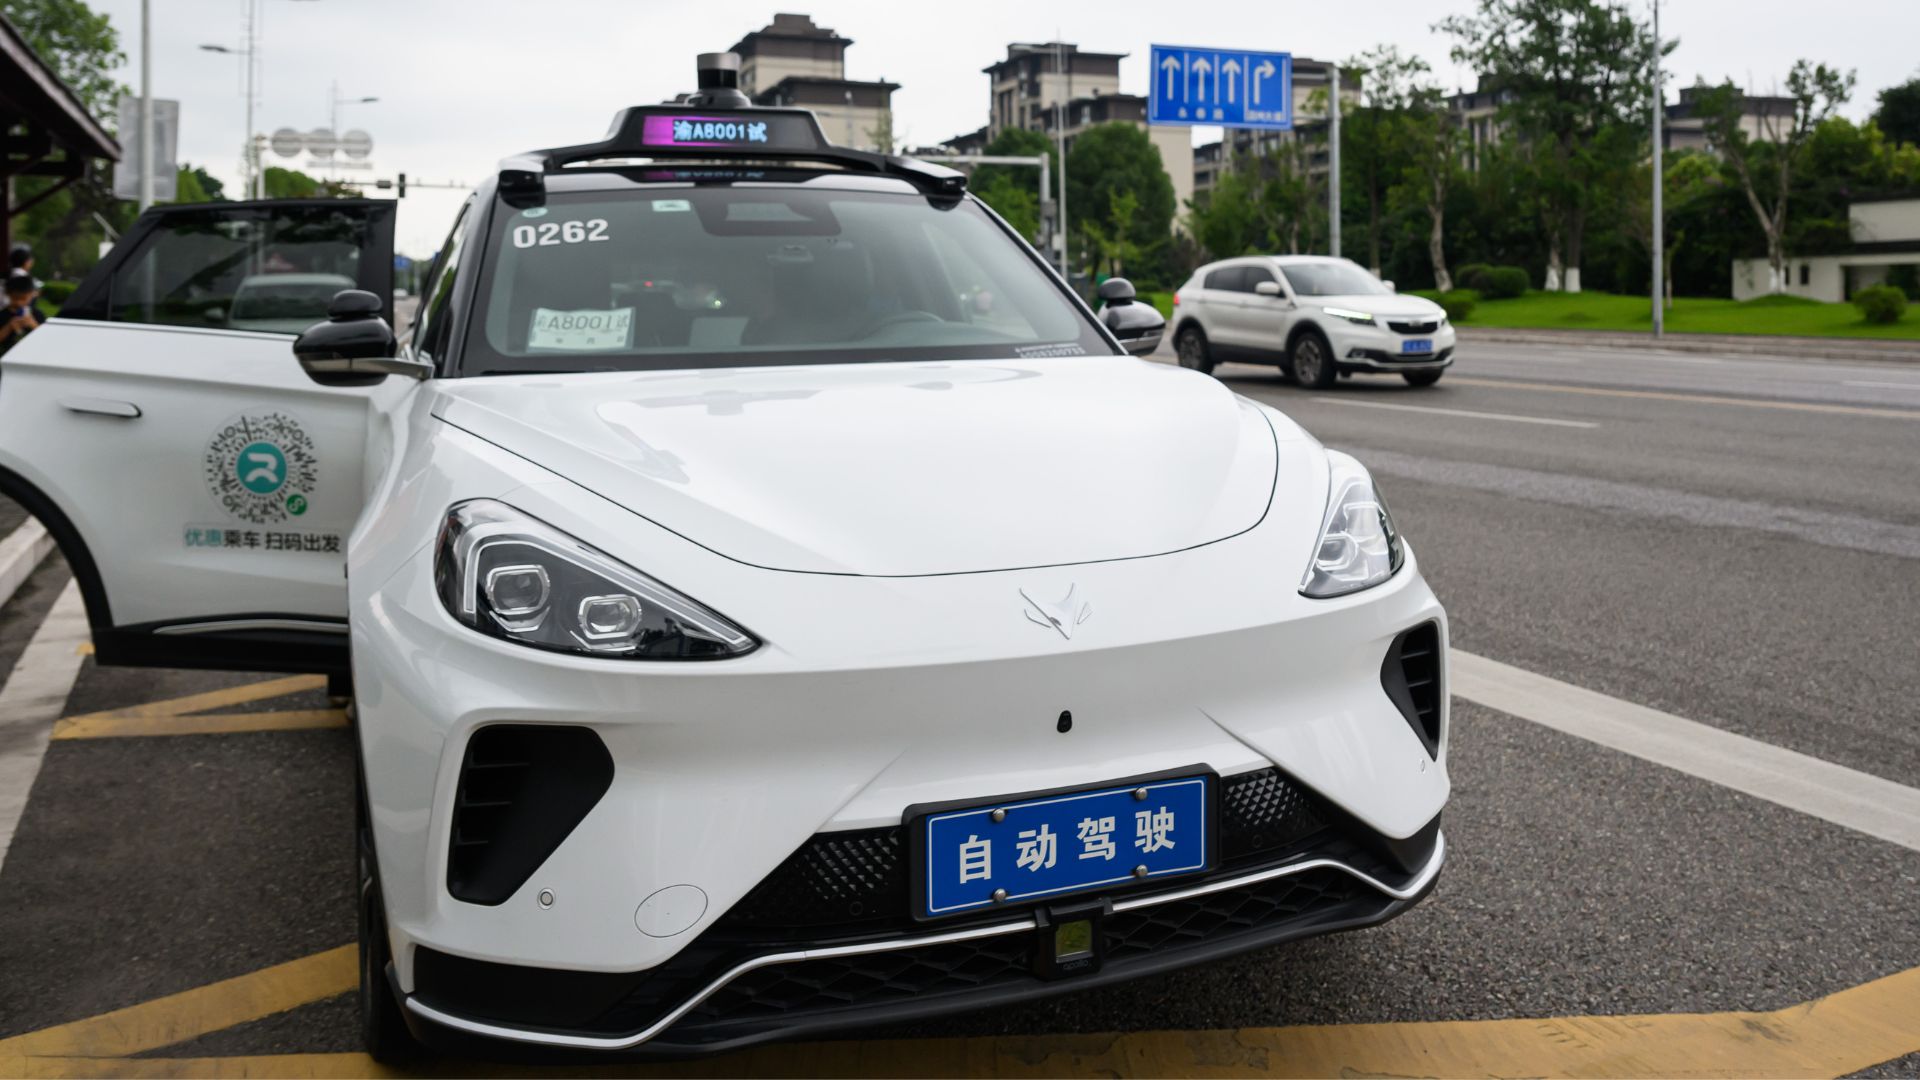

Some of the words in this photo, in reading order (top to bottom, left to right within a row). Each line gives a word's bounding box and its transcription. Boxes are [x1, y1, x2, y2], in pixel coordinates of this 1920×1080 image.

[513, 218, 610, 248] 0262
[185, 529, 261, 548] 优惠乘车
[266, 532, 341, 553] 扫码出发
[959, 806, 1176, 884] 自动驾驶
